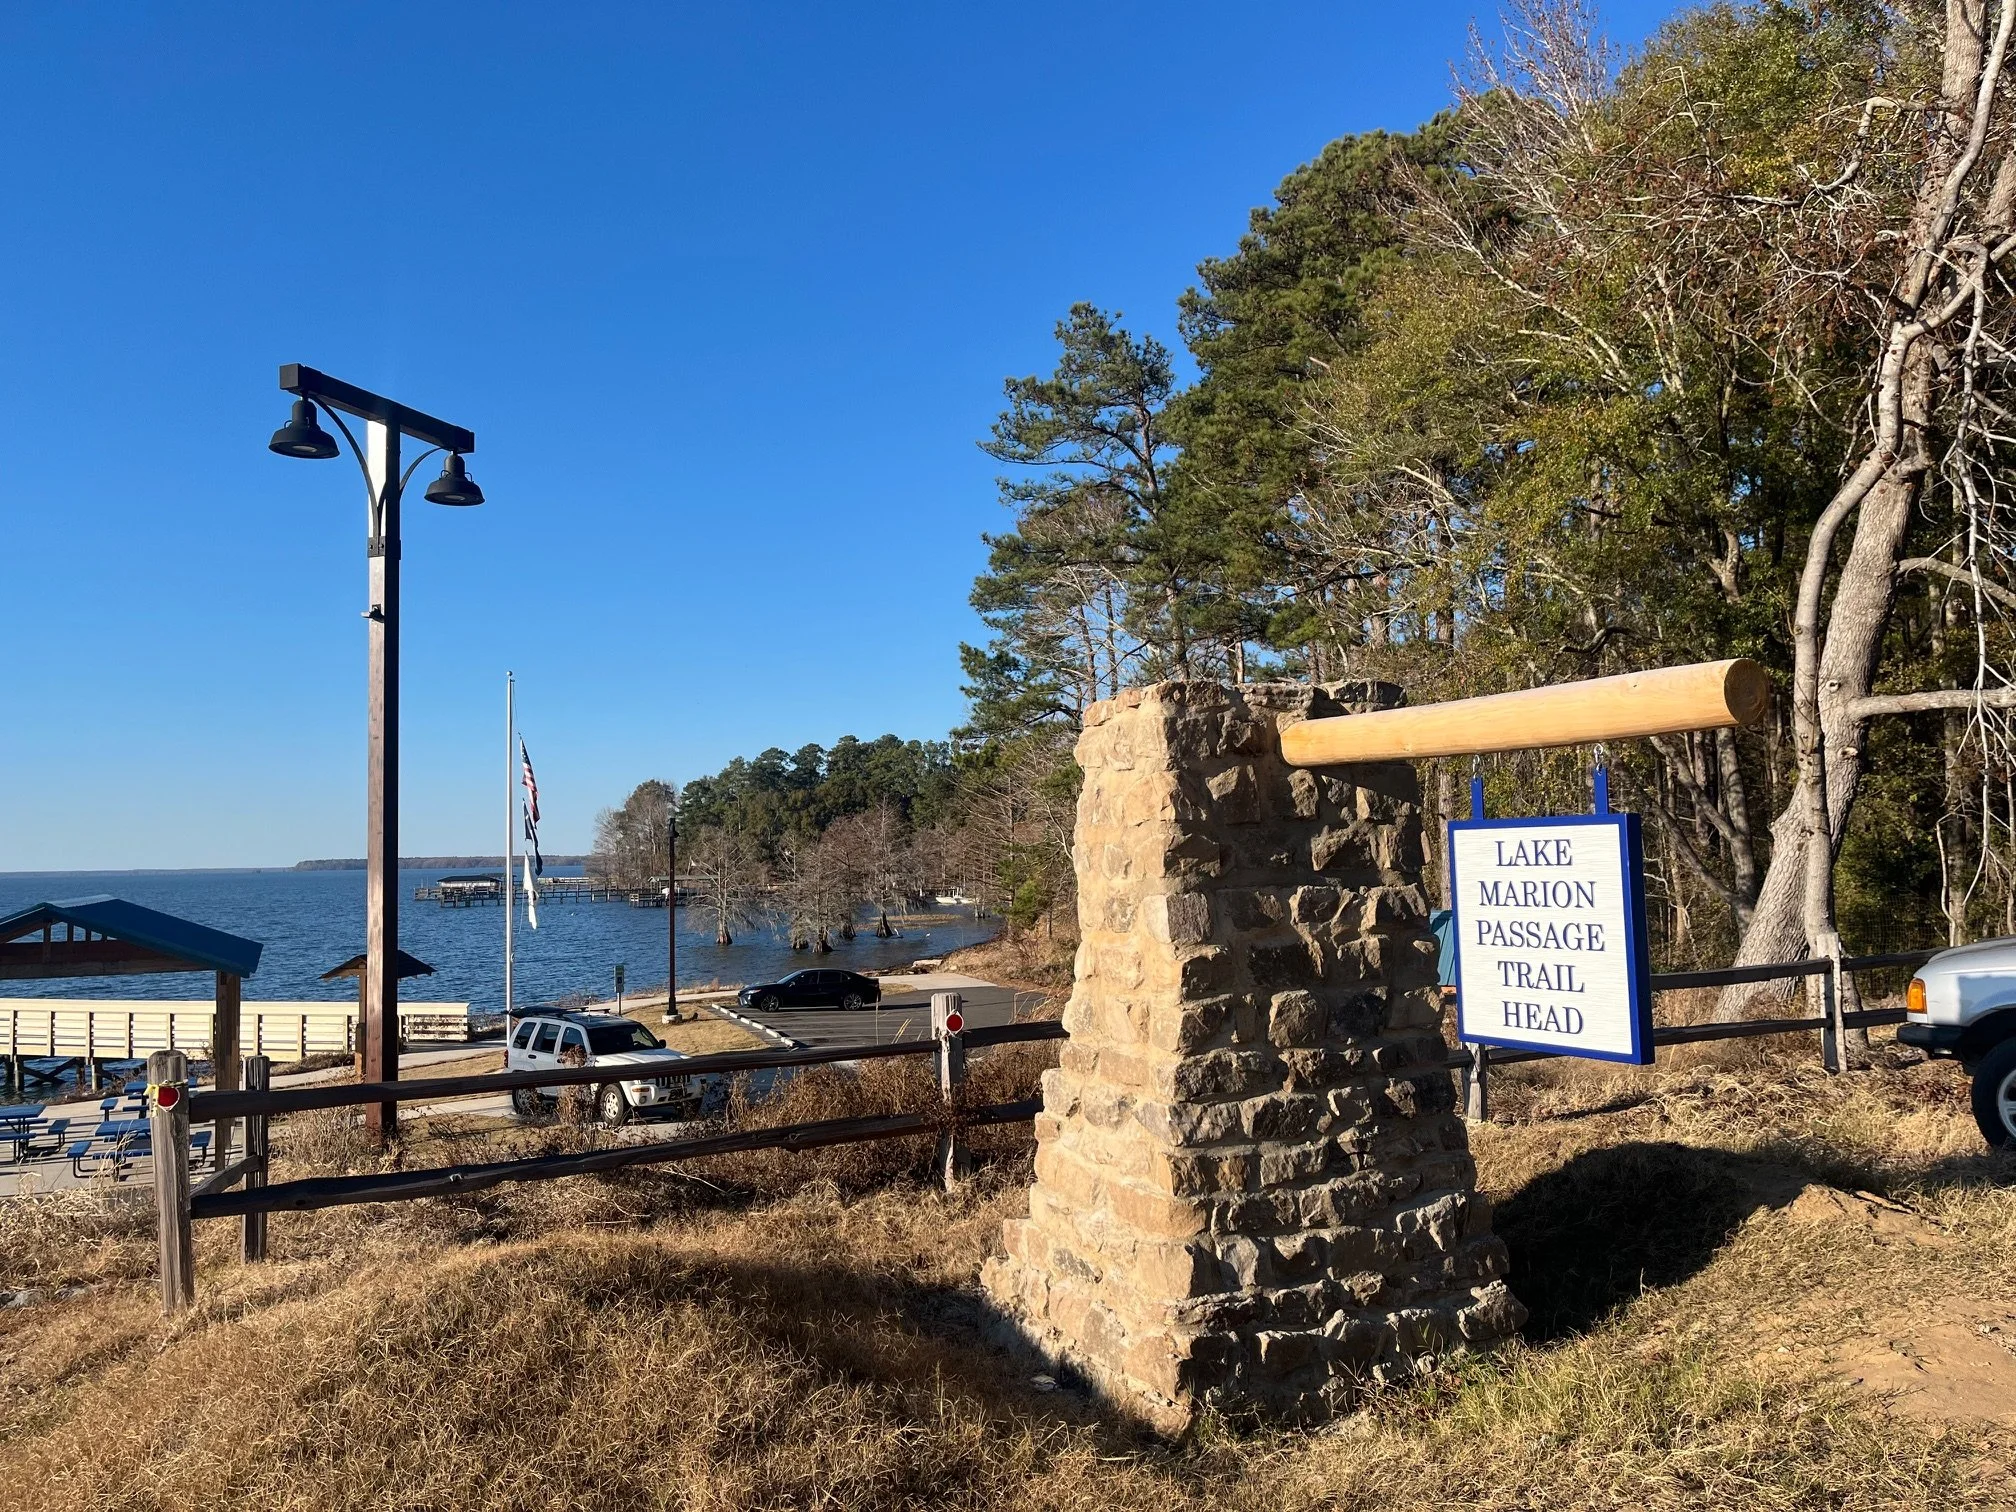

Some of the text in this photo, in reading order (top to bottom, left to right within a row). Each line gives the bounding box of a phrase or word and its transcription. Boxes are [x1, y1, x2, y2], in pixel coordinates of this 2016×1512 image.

[1495, 839, 1573, 867] LAKE
[1478, 881, 1596, 909] MARION
[1476, 920, 1605, 952] PASSAGE
[1498, 961, 1585, 993] TRAIL
[1502, 1001, 1584, 1035] HEAD
